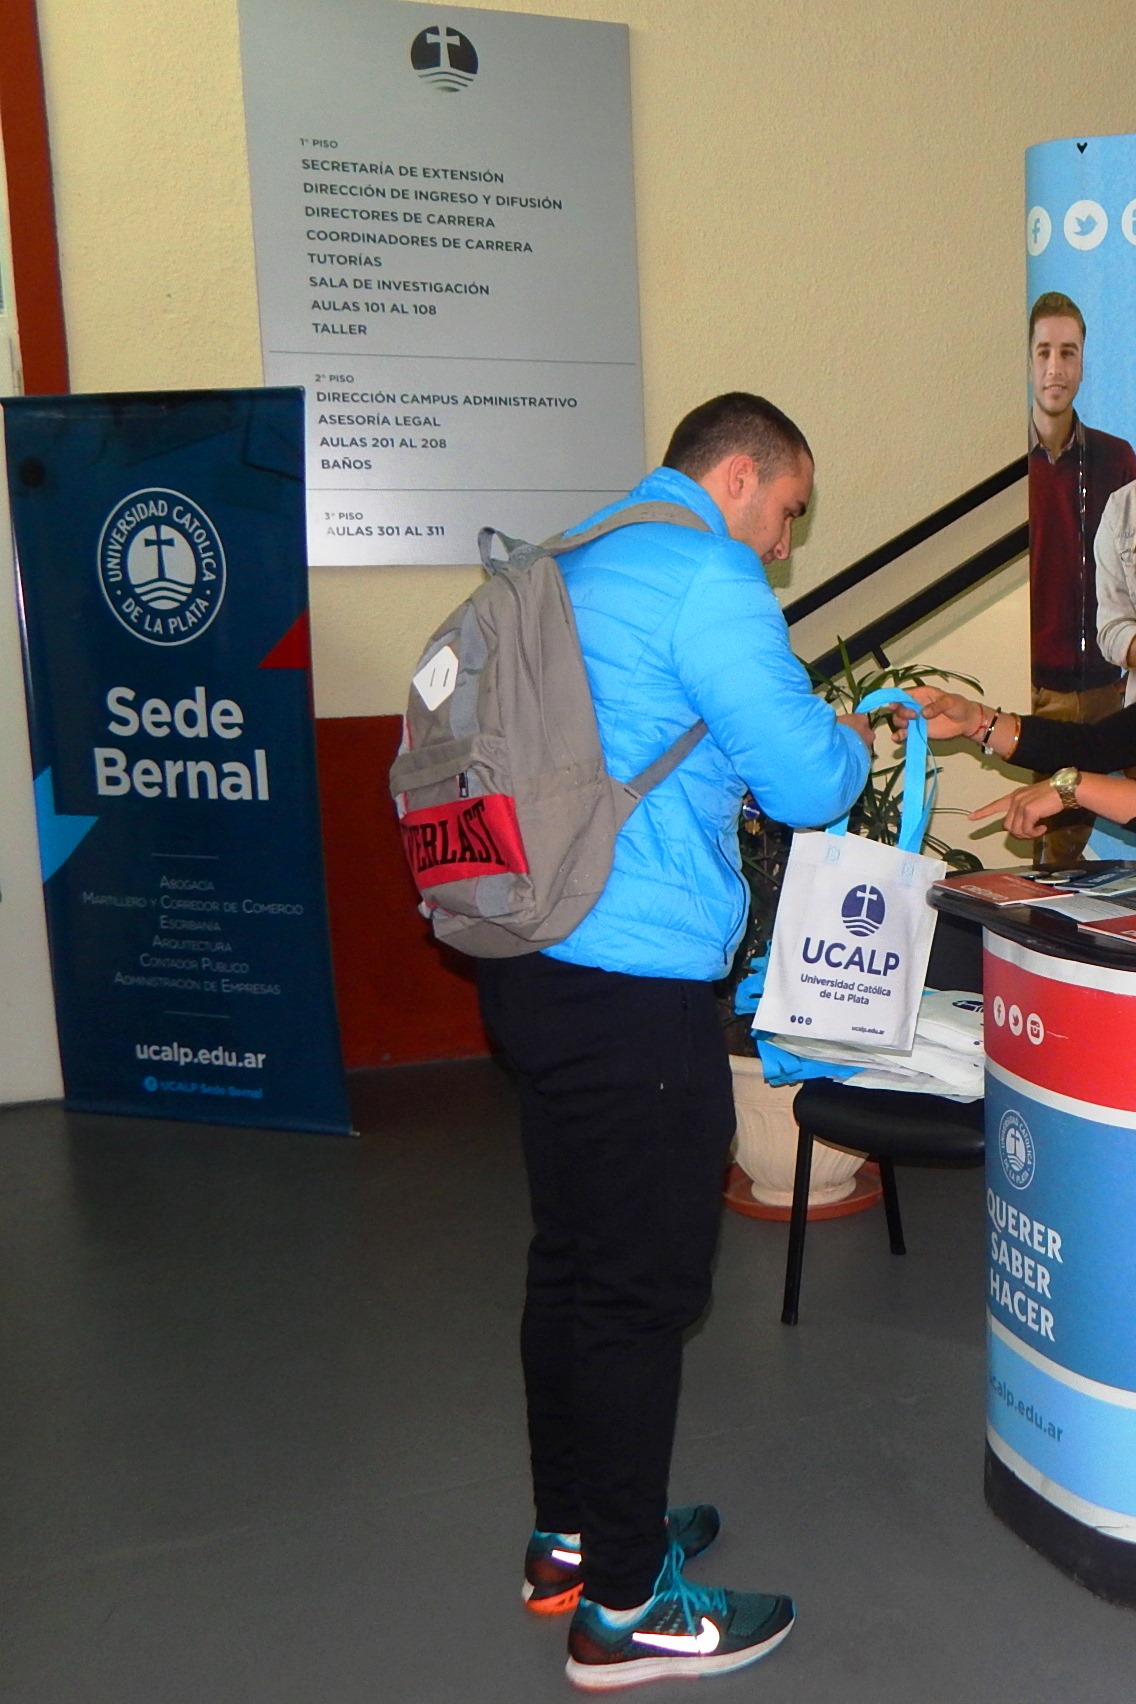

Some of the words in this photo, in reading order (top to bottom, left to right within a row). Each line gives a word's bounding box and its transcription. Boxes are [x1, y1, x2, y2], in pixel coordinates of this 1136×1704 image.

[313, 138, 338, 149] PISO
[302, 158, 394, 176] SECRETARÍA
[399, 165, 418, 177] DE
[422, 167, 505, 184] EXTENSIÓN
[303, 181, 386, 199] DIRECCIÓN
[390, 187, 410, 200] DE
[414, 189, 479, 205] INGRESO
[482, 193, 491, 205] Y
[496, 195, 562, 211] DIFUSIÓN
[305, 206, 399, 223] DIRECTORES
[403, 211, 422, 224] DE
[426, 213, 496, 228] CARRERA
[306, 229, 438, 248] COORDINADORES
[442, 237, 461, 249] DE
[465, 238, 533, 253] CARRERA
[307, 252, 383, 268] TUTORÍAS
[309, 276, 348, 289] SALA
[353, 278, 373, 290] DE
[377, 279, 490, 296] INVESTIGACIÓN
[311, 300, 361, 313] AULAS
[364, 301, 386, 313] 101
[390, 302, 409, 314] AL
[413, 303, 437, 316] 108
[312, 322, 368, 336] TALLER
[329, 374, 354, 383] PISO
[316, 390, 396, 404] DIRECCIÓN
[400, 393, 459, 406] CAMPUS
[462, 395, 578, 408] ADMINISTRATIVO
[318, 412, 391, 426] ASESORÍA
[395, 415, 441, 427] LEGAL
[320, 436, 368, 448] AULAS
[371, 437, 395, 449] 201
[399, 438, 417, 449] AL
[421, 438, 447, 449] 208
[321, 457, 373, 471] BAÑOS
[338, 512, 364, 521] PISO
[108, 500, 168, 583] UNIVERSIDAD
[172, 505, 217, 582] CATOLICA
[326, 525, 374, 537] AULAS
[377, 525, 400, 537] 301
[404, 525, 423, 537] AL
[426, 525, 445, 537] 311
[121, 597, 142, 624] DE
[144, 613, 164, 635] LA
[168, 597, 211, 635] PLATA
[106, 686, 244, 738] Sede
[94, 747, 270, 801] Bernal
[802, 937, 900, 977] UCALP
[801, 973, 855, 991] Universidad
[857, 983, 892, 997] Católica
[819, 989, 831, 999] de
[834, 991, 844, 1001] La
[847, 993, 870, 1005] Plata
[851, 1025, 885, 1035] ucalp.edu.ar
[136, 1042, 266, 1069] ucalp.edu.ar
[986, 1187, 1064, 1264] QUERER
[991, 1232, 1052, 1299] SABER
[989, 1267, 1056, 1342] HACER
[990, 1375, 1064, 1442] calp.edu.ar
